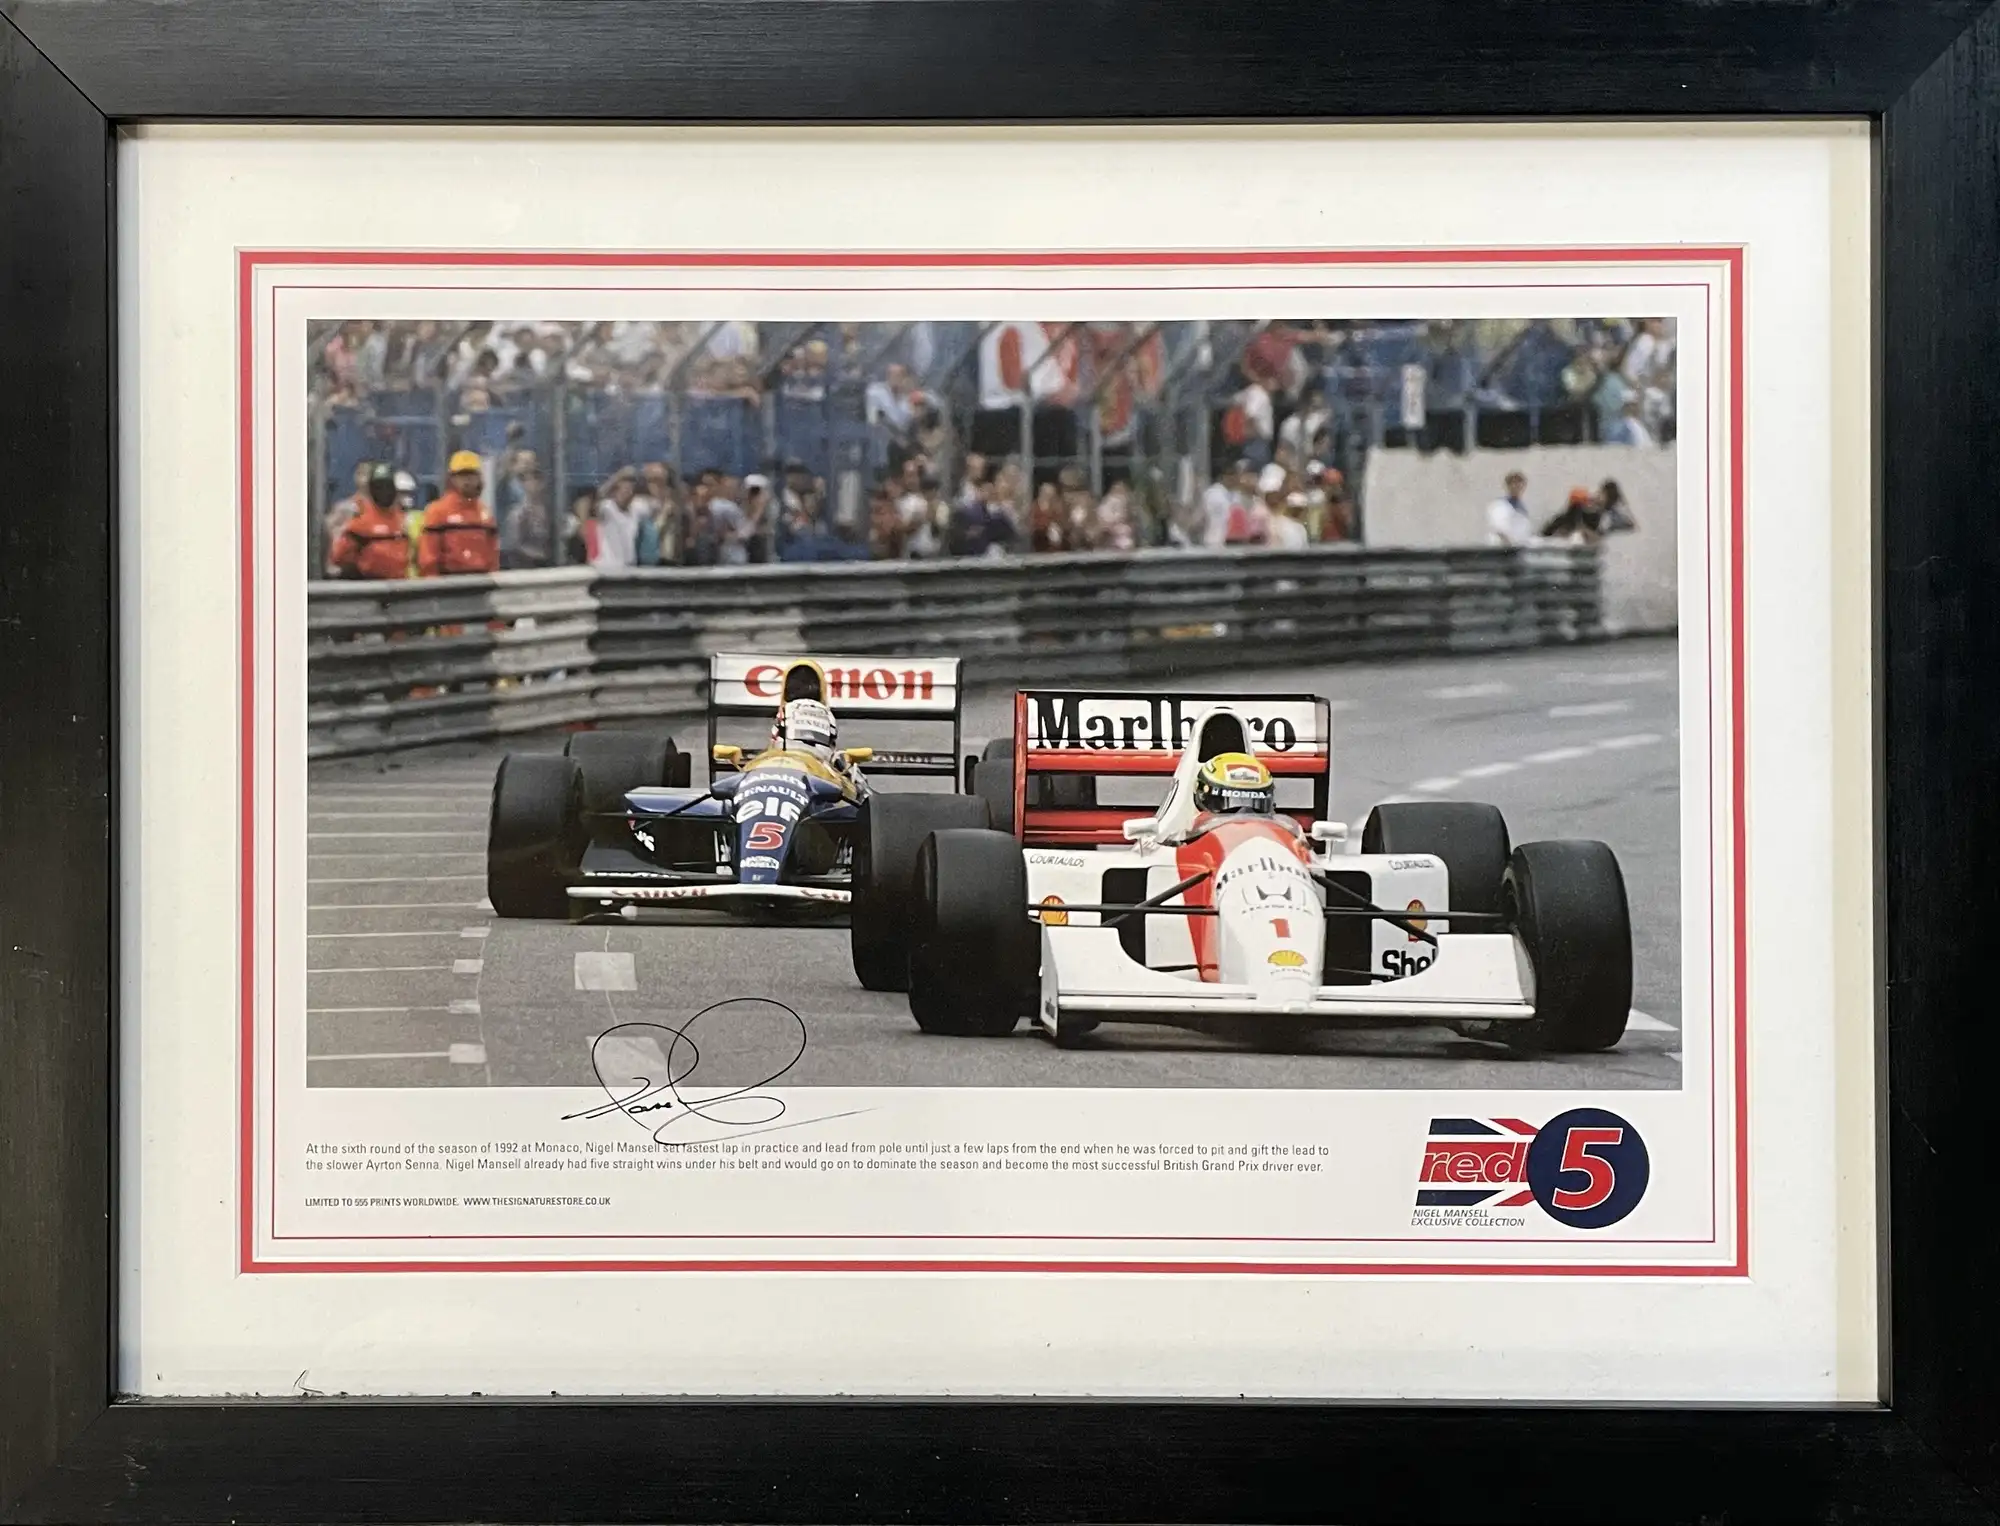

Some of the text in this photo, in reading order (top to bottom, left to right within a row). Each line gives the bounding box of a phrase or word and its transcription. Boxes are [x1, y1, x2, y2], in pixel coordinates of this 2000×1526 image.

[744, 665, 934, 701] Cnon
[746, 821, 786, 850] 5
[1269, 918, 1292, 938] 1
[1382, 948, 1437, 977] She
[306, 1142, 1330, 1159] At the sixth round of the season of 1992 at Monaco, Nigel Mansell set fastest lap in practice and lead from pole until just a few laps from the end when he was forced to pit and gift the lead to
[306, 1158, 324, 1170] the
[326, 1158, 364, 1170] slower
[366, 1158, 402, 1173] Ayrton
[446, 1158, 474, 1173] Nigel
[478, 1158, 522, 1170] Mansell
[524, 1158, 564, 1173] already
[568, 1158, 588, 1170] had
[590, 1158, 610, 1169] five
[612, 1158, 654, 1172] straight
[656, 1158, 682, 1169] wins
[684, 1158, 716, 1169] under
[720, 1158, 736, 1169] his
[738, 1158, 758, 1169] belt
[762, 1158, 782, 1169] and
[784, 1158, 818, 1169] would
[820, 1161, 834, 1172] go
[836, 1161, 850, 1170] on
[852, 1158, 864, 1170] to
[866, 1158, 916, 1170] dominate
[920, 1159, 936, 1170] the
[940, 1161, 978, 1170] season
[982, 1159, 1002, 1170] and
[1006, 1159, 1048, 1170] become
[1052, 1159, 1068, 1171] the
[1072, 1159, 1098, 1171] most
[1102, 1159, 1160, 1171] successful
[1164, 1160, 1198, 1171] British
[1202, 1160, 1234, 1171] Grand
[1238, 1160, 1260, 1172] Prix
[1262, 1160, 1294, 1172] driver
[1296, 1163, 1324, 1172] ever.
[1424, 1142, 1530, 1183] red
[1551, 1127, 1624, 1211] 5
[304, 1198, 340, 1207] LIMITED
[340, 1198, 352, 1207] TO
[354, 1198, 368, 1207] 555
[370, 1198, 402, 1207] PRINTS
[1411, 1218, 1525, 1226] EXCLUSIVE COLLECTION
[1413, 1209, 1489, 1217] NIGEL MANSELL
